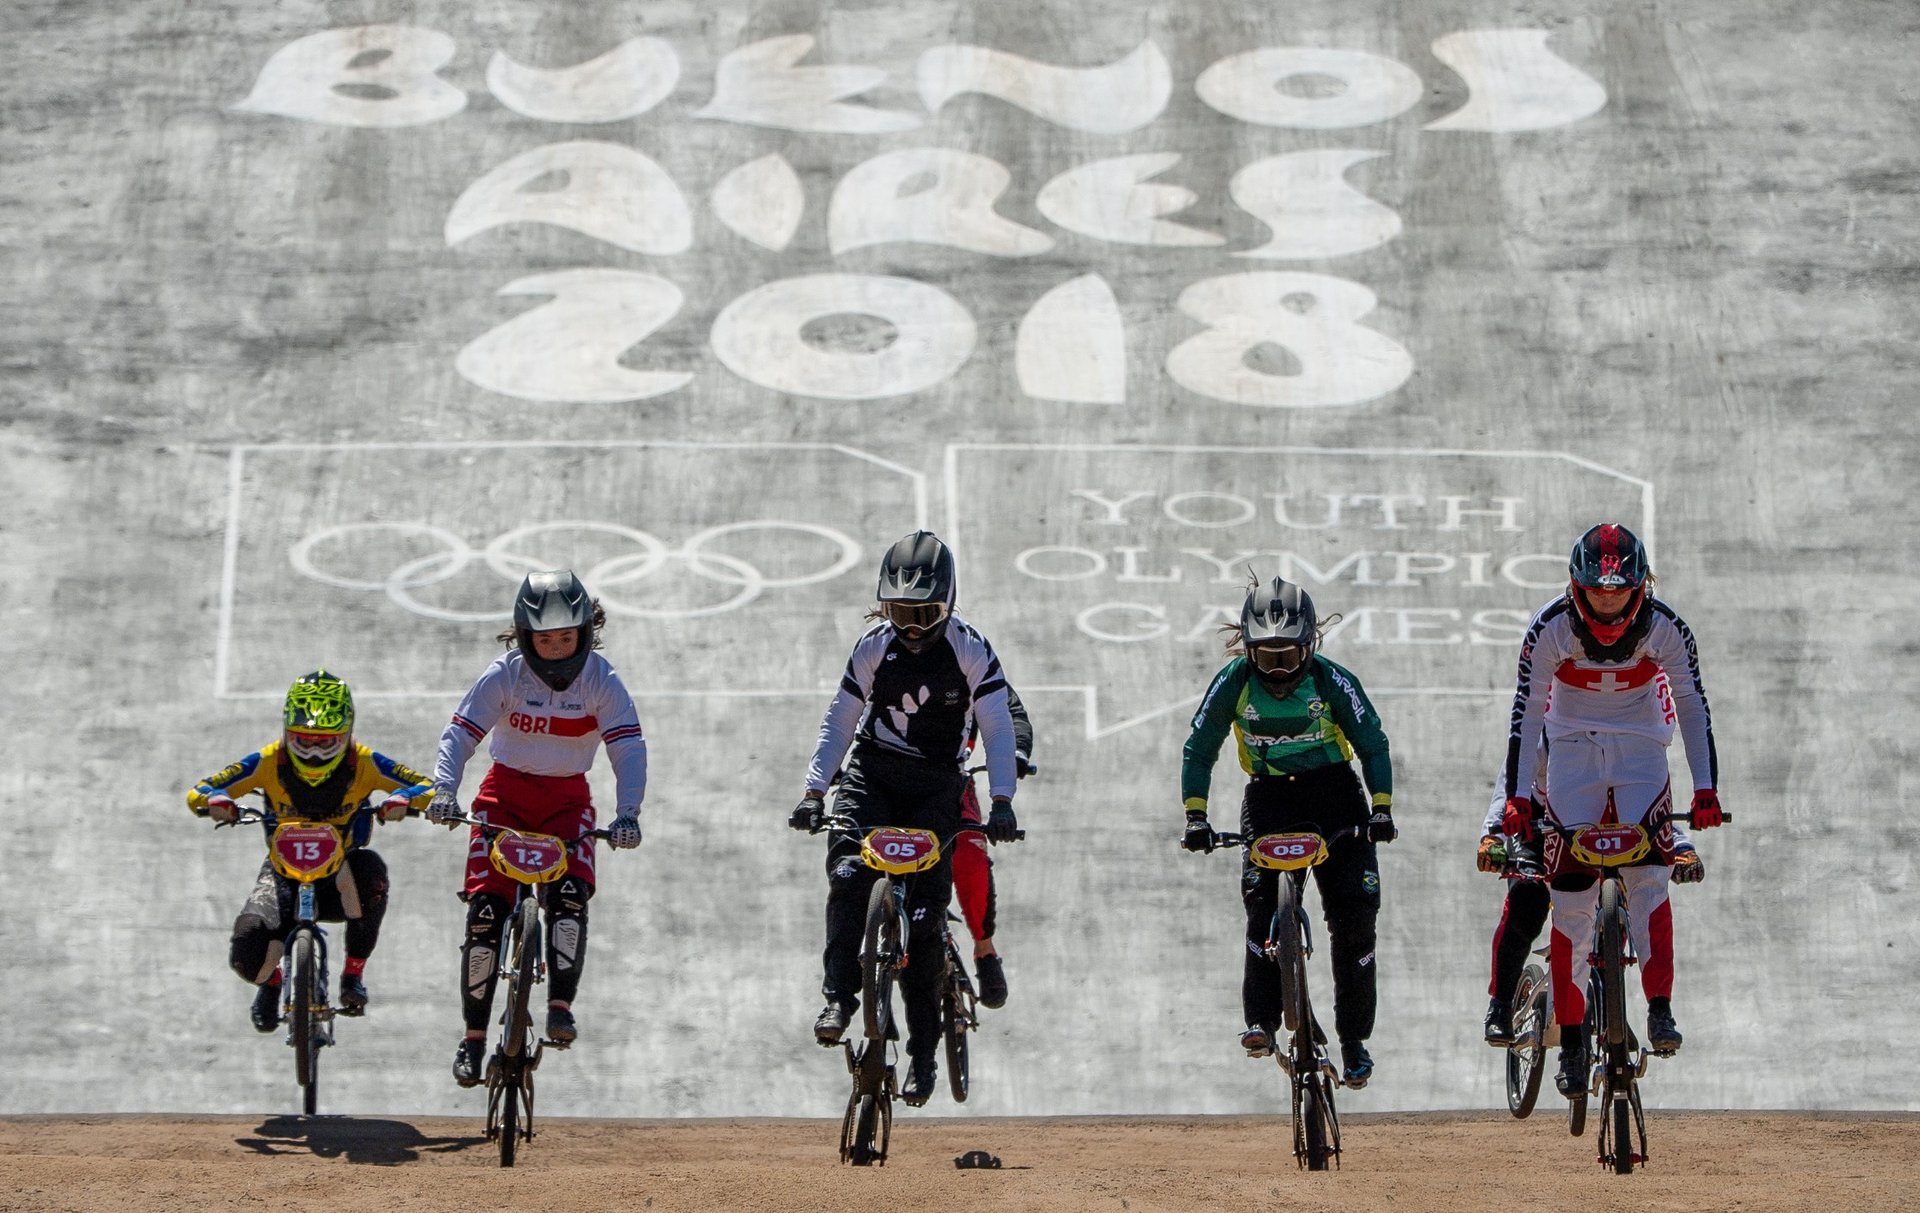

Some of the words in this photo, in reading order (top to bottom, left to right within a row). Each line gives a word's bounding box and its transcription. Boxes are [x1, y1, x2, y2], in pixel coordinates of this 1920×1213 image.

[229, 24, 1607, 133] BUENOS
[444, 140, 1401, 259] AIRES
[455, 268, 1414, 407] 2018
[1071, 490, 1525, 532] YOUTH
[1331, 667, 1365, 723] BRASIL
[509, 712, 548, 734] GBR
[293, 842, 320, 860] 13
[884, 842, 916, 856] 05
[1273, 845, 1305, 855] 08
[1595, 837, 1621, 850] 01
[515, 848, 543, 866] 12
